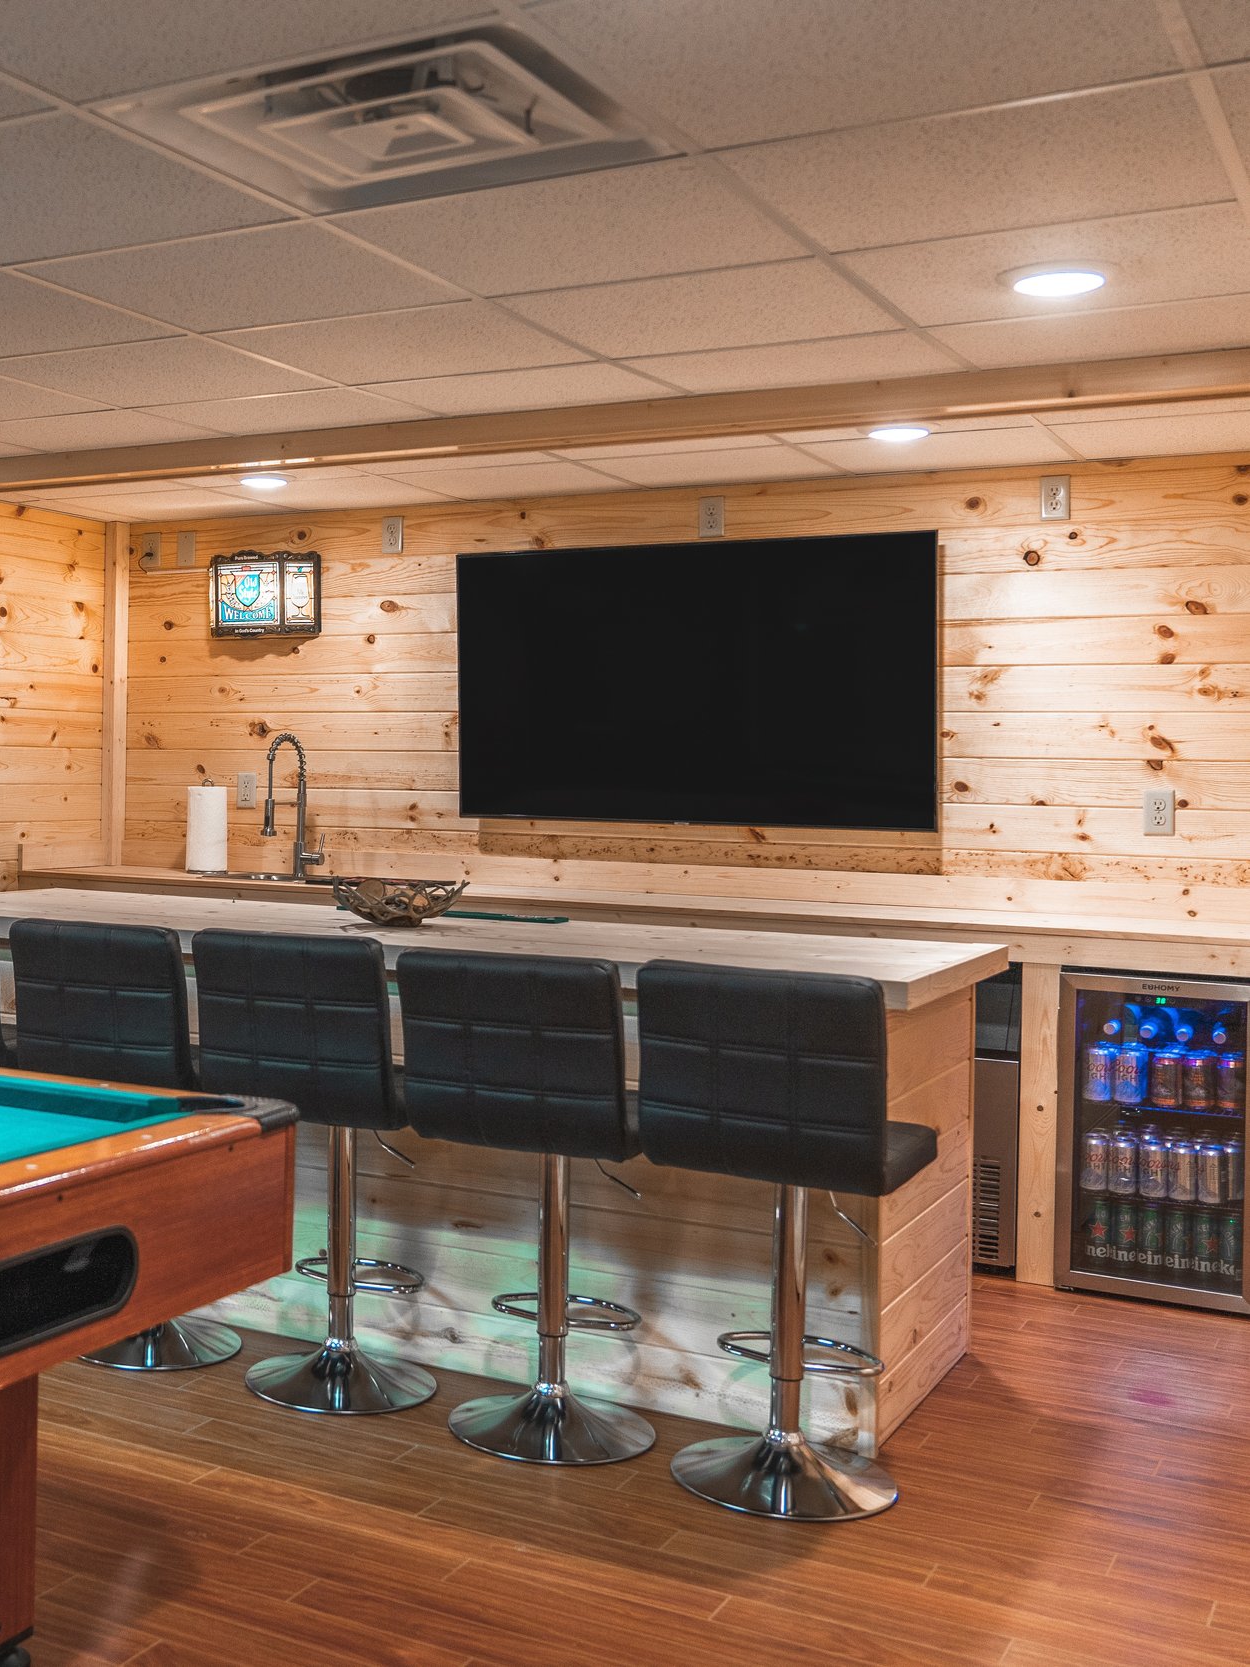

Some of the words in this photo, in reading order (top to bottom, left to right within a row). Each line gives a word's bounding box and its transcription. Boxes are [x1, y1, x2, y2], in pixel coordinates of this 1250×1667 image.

[244, 575, 257, 588] Old
[224, 605, 272, 620] WELCOME
[1142, 983, 1180, 991] EUHOMY
